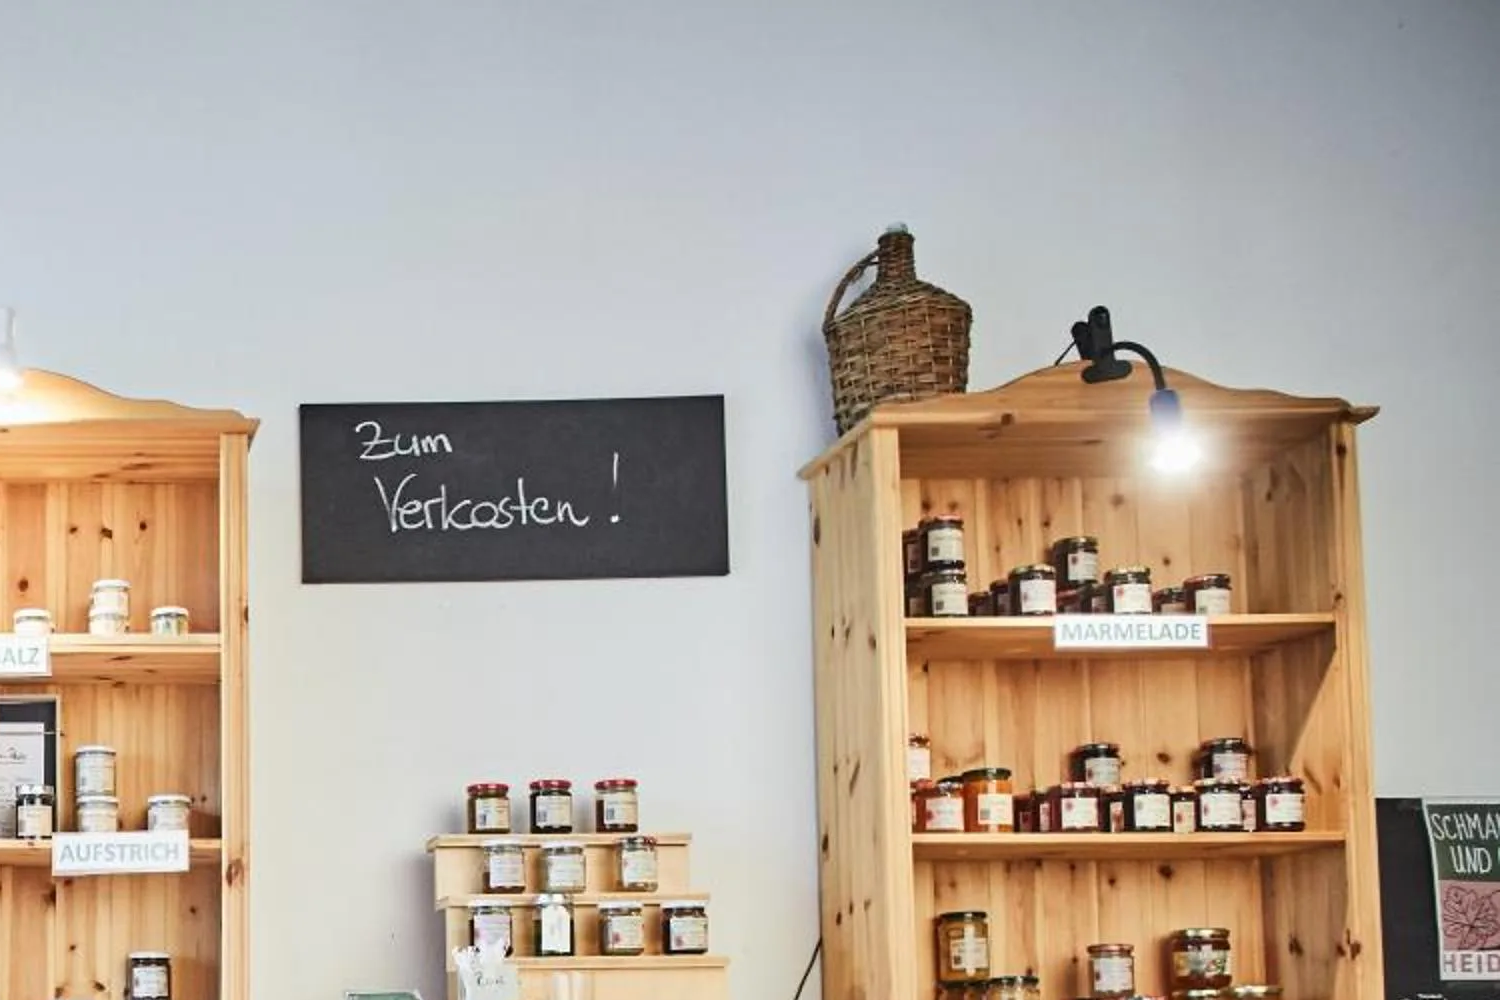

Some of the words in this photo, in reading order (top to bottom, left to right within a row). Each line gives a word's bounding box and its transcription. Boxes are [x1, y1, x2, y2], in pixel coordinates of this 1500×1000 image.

[354, 420, 454, 461] Zum
[373, 472, 591, 534] Verkosten
[1060, 621, 1202, 642] MARMELADE
[1431, 811, 1500, 842] SCHMA
[58, 841, 181, 864] AUFSTRICH
[1449, 845, 1493, 875] UND
